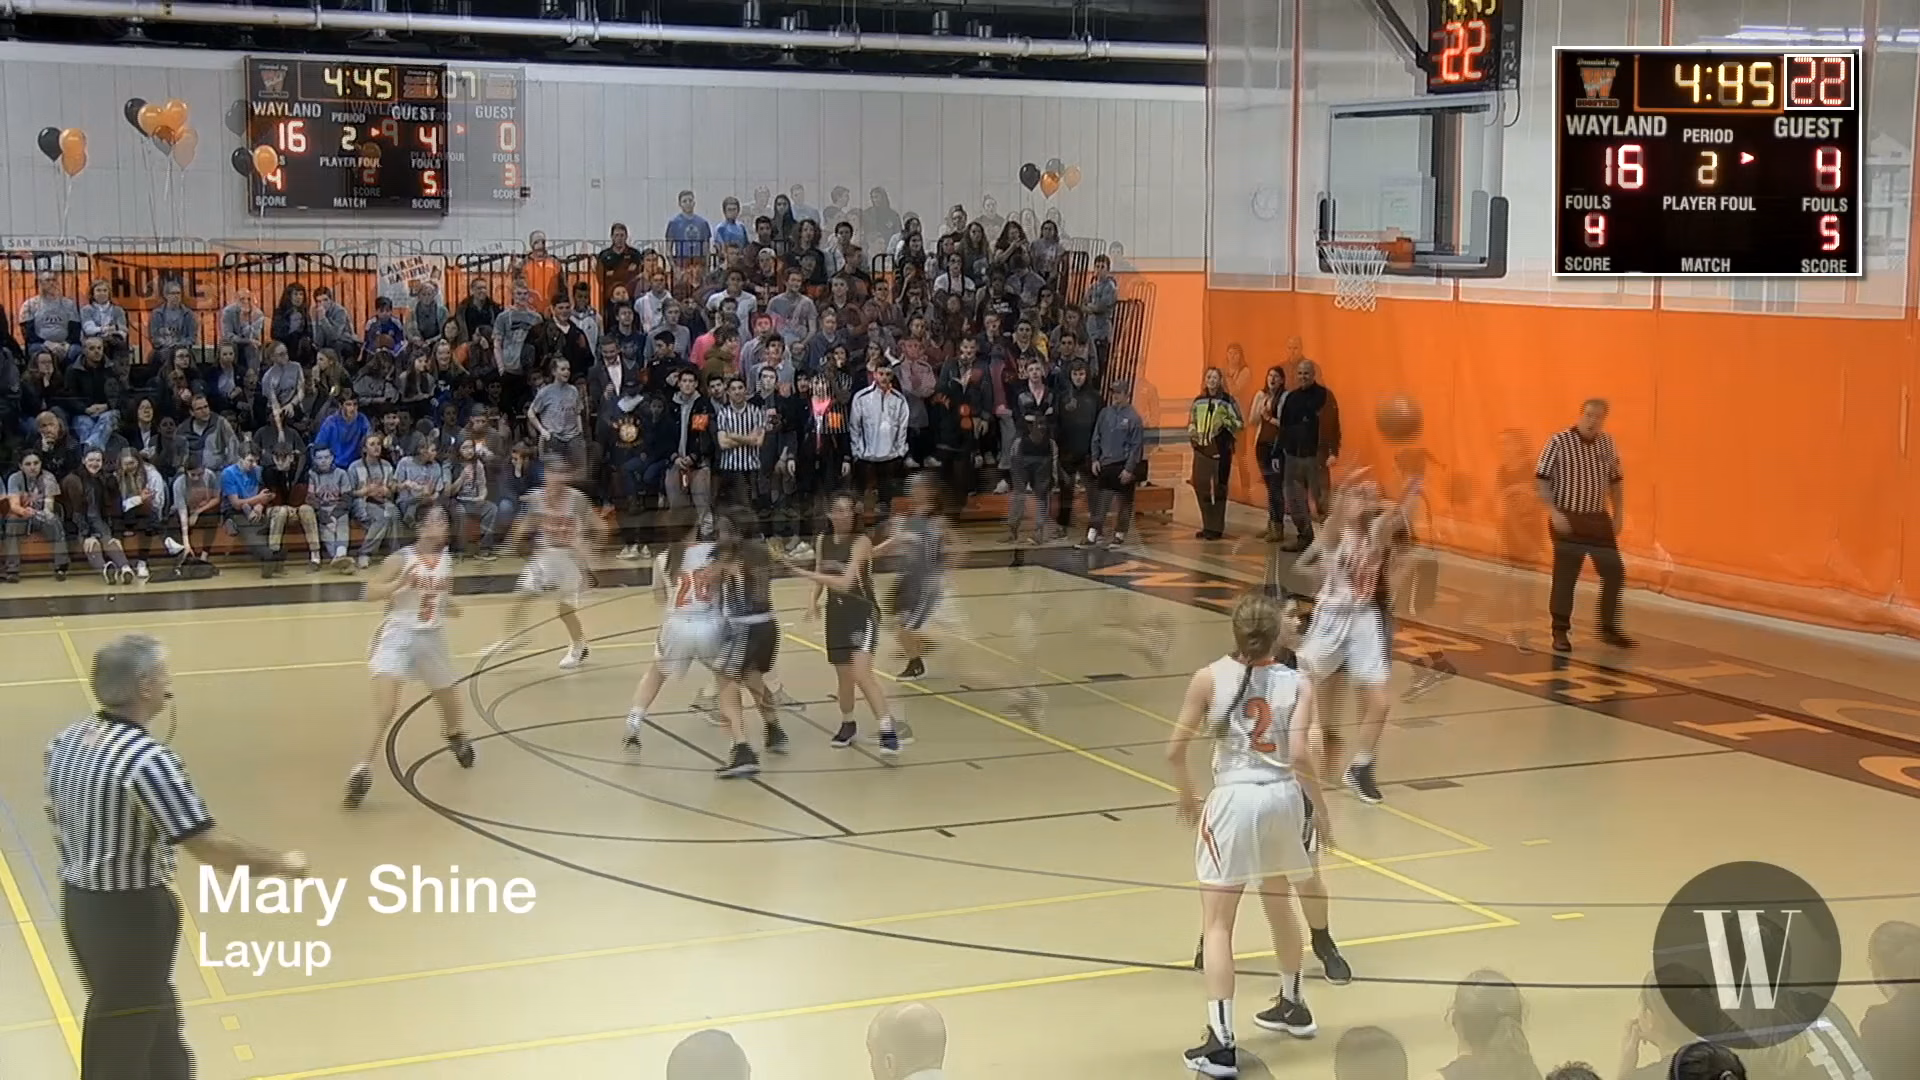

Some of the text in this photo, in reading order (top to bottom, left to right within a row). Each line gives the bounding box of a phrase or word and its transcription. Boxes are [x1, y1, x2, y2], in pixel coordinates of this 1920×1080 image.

[324, 67, 392, 100] 4:45
[252, 101, 321, 118] WAYLAND
[391, 106, 437, 121] GUEST
[475, 106, 517, 119] GUEST
[278, 120, 307, 152] 16
[341, 126, 357, 150] 2
[419, 126, 437, 155] 4
[492, 153, 520, 163] FOULS
[423, 170, 437, 194] 5
[255, 195, 287, 207] SCORE
[333, 197, 366, 208] MATCH
[411, 198, 442, 209] SCORE
[1242, 697, 1277, 752] 2
